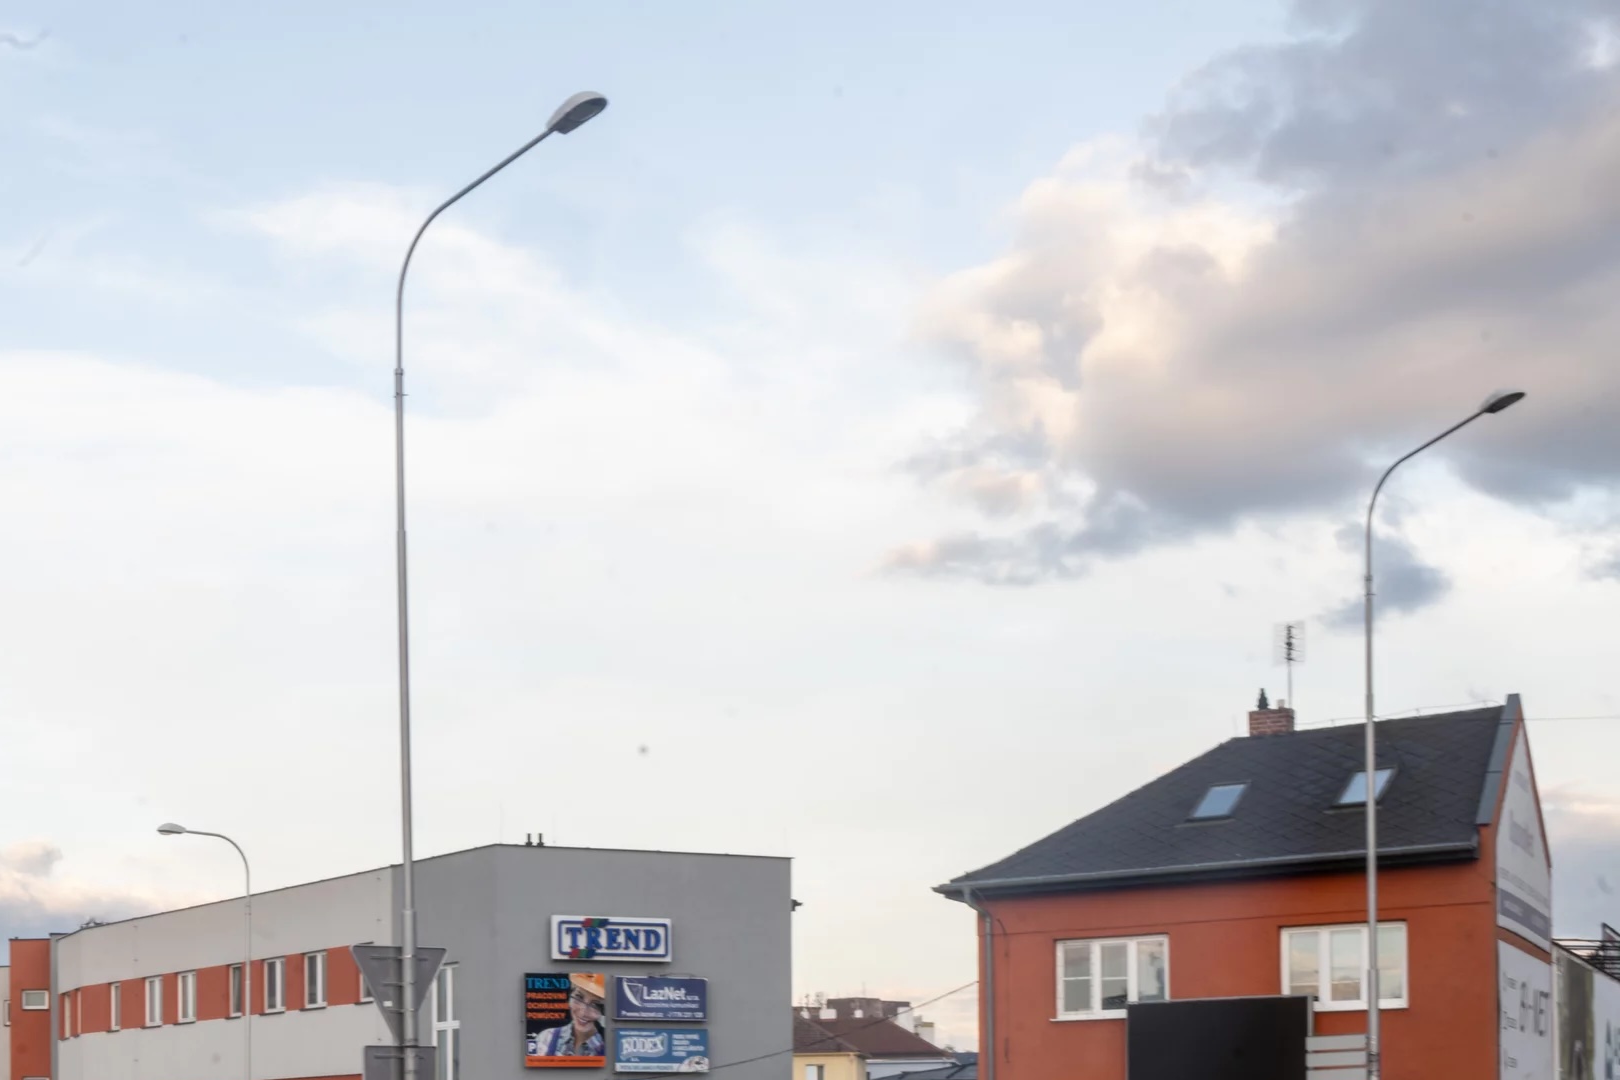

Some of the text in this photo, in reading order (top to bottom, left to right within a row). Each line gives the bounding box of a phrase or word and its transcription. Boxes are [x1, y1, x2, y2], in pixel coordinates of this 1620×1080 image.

[566, 927, 661, 950] TREND
[526, 978, 570, 989] TREND
[643, 986, 686, 1000] LazNet
